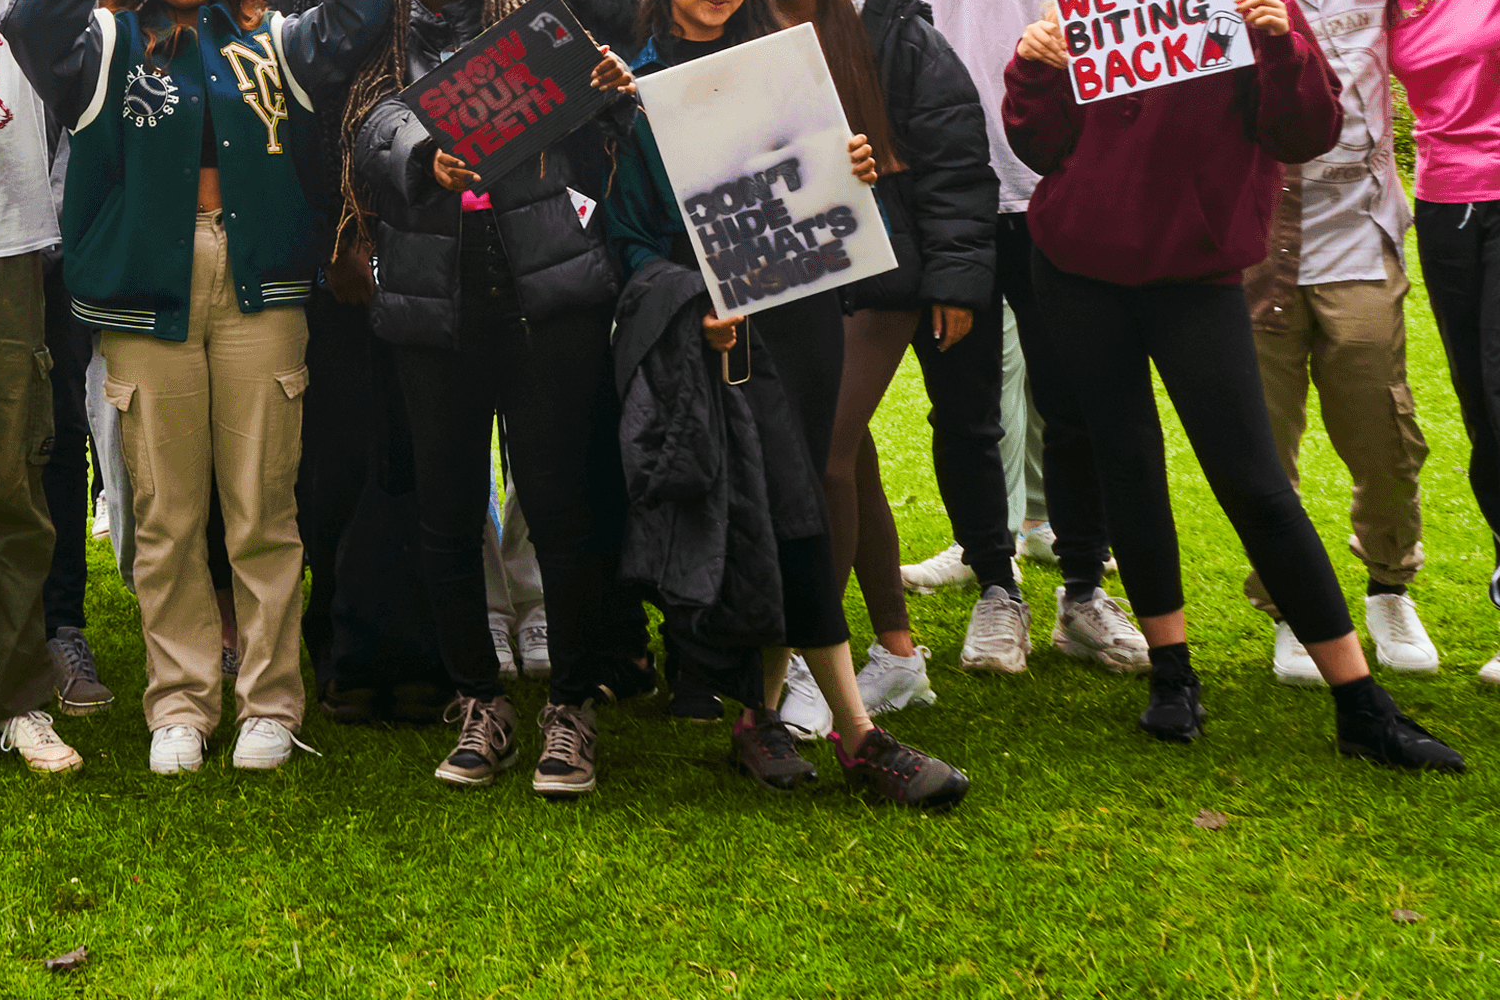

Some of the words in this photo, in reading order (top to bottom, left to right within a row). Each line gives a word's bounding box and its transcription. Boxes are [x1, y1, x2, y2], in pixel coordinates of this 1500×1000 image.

[419, 29, 527, 119] SHOW
[434, 62, 540, 141] YOUR
[1073, 32, 1197, 101] BACK
[452, 77, 567, 166] TEETH
[697, 198, 792, 255] HIDE
[706, 205, 858, 281] WHAT'S
